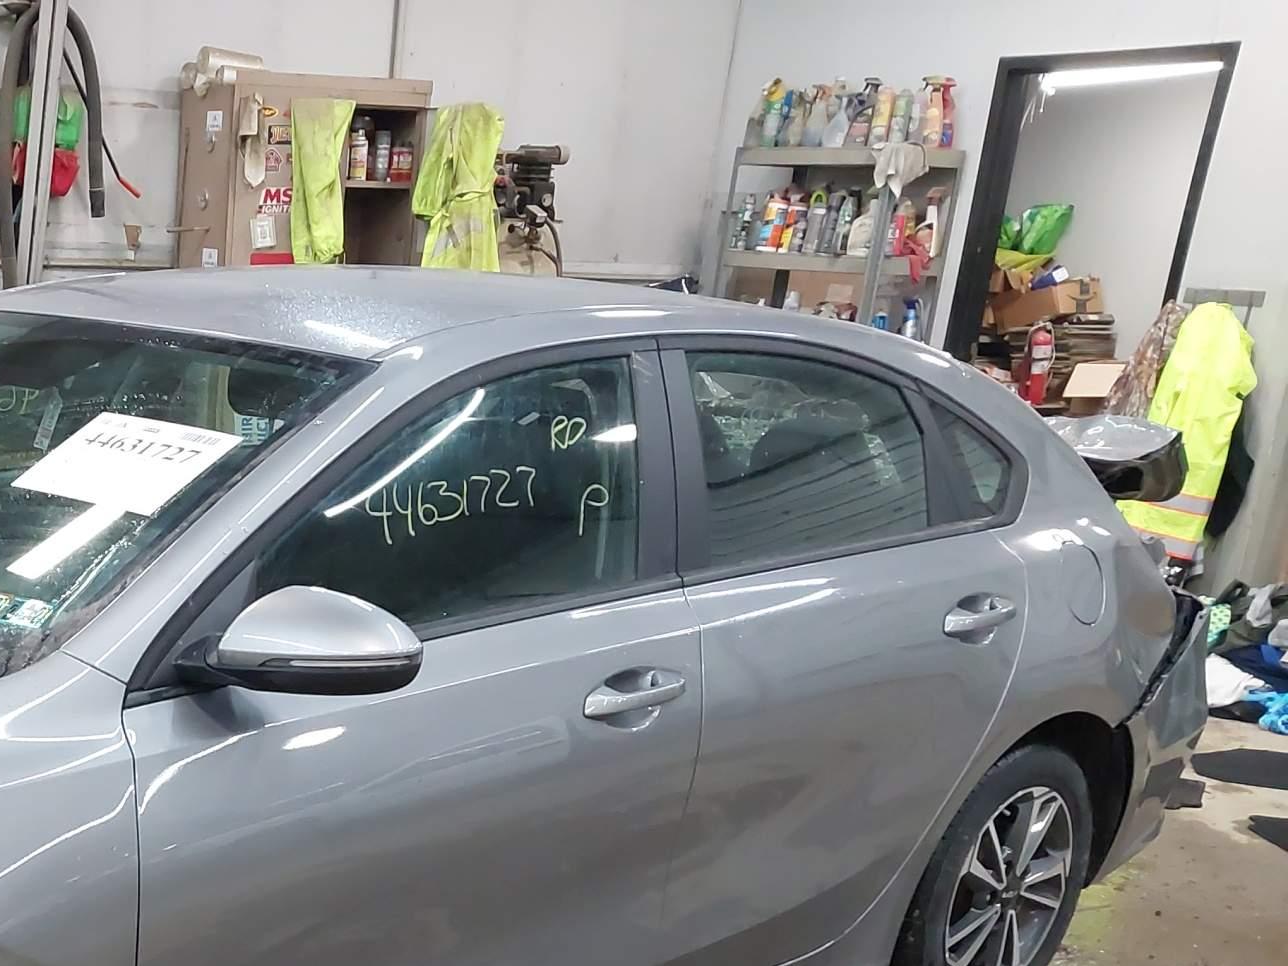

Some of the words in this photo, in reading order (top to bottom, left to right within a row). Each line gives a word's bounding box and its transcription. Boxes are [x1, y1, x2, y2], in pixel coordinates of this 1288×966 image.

[84, 431, 203, 464] 44631727
[365, 465, 536, 545] 44631727
[579, 483, 610, 537] P
